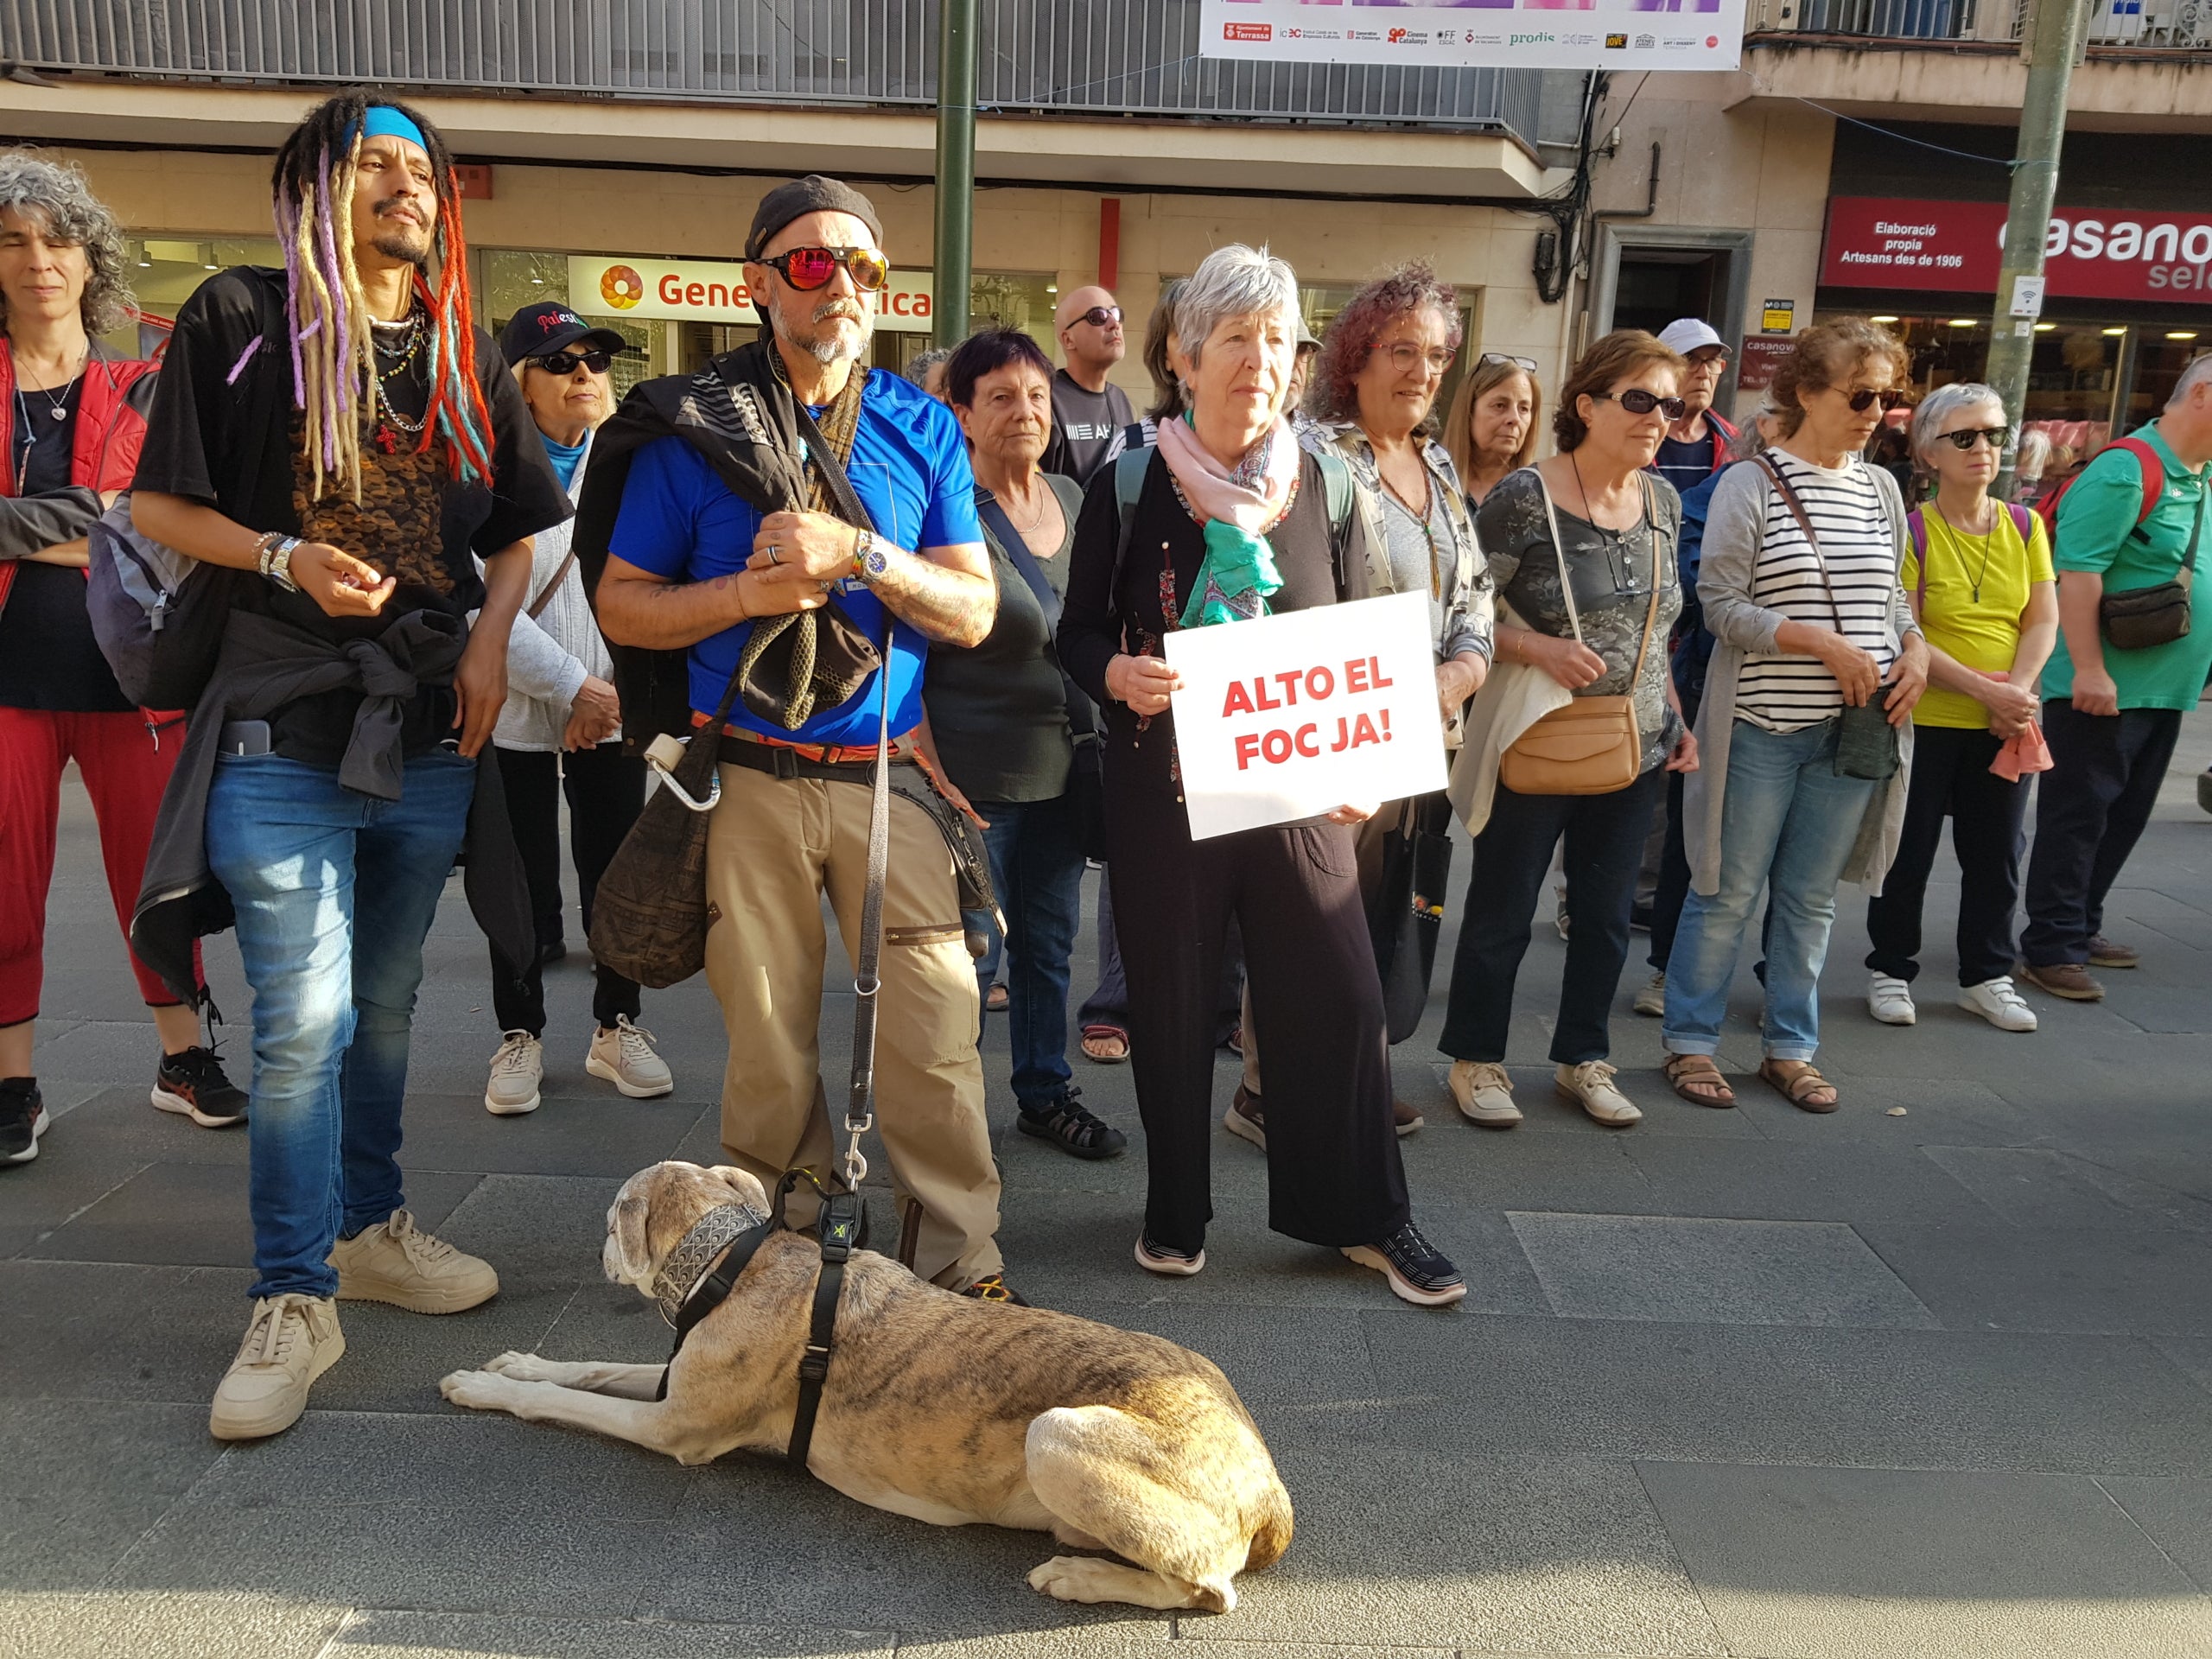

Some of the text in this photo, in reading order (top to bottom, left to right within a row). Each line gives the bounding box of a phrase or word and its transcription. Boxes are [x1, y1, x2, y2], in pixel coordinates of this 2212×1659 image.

[1236, 31, 1270, 40] Terrassa
[1399, 37, 1427, 46] Catalunya
[1510, 32, 1555, 46] prodis
[1875, 221, 1936, 236] Elaboració
[1885, 238, 1923, 251] propia
[1999, 218, 2212, 264] asano
[1841, 251, 1962, 267] Artesans des de 1906
[2148, 264, 2212, 290] sel
[658, 274, 931, 317] Gene ica
[1222, 656, 1394, 718] ALTO EL
[1235, 709, 1393, 771] FOC JA!
